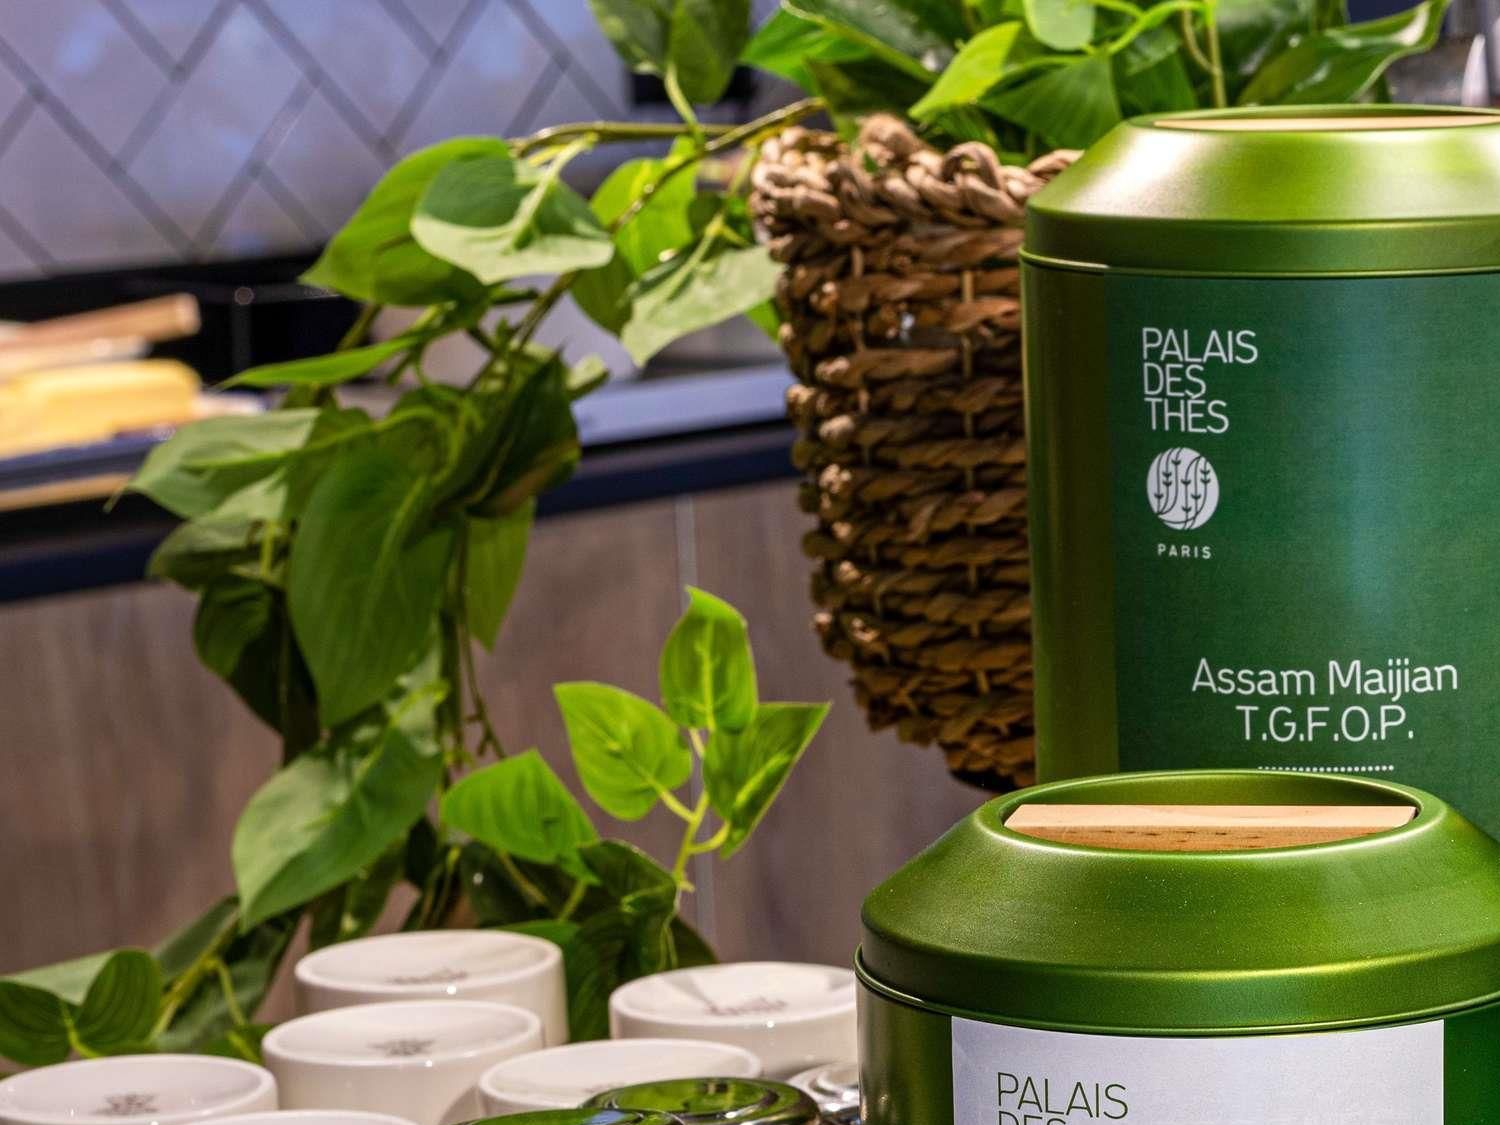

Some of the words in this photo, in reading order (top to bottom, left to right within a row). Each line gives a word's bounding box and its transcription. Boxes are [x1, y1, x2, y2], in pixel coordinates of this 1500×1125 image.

[1142, 327, 1258, 364] PALAIS
[1144, 362, 1205, 400] DES
[1144, 394, 1229, 434] THÉS
[1157, 542, 1211, 560] PARIS
[1191, 658, 1315, 697] Assam
[1329, 657, 1459, 702] Maijian
[1235, 705, 1415, 743] T.G.F.O.P.
[998, 1072, 1129, 1119] PALAIS
